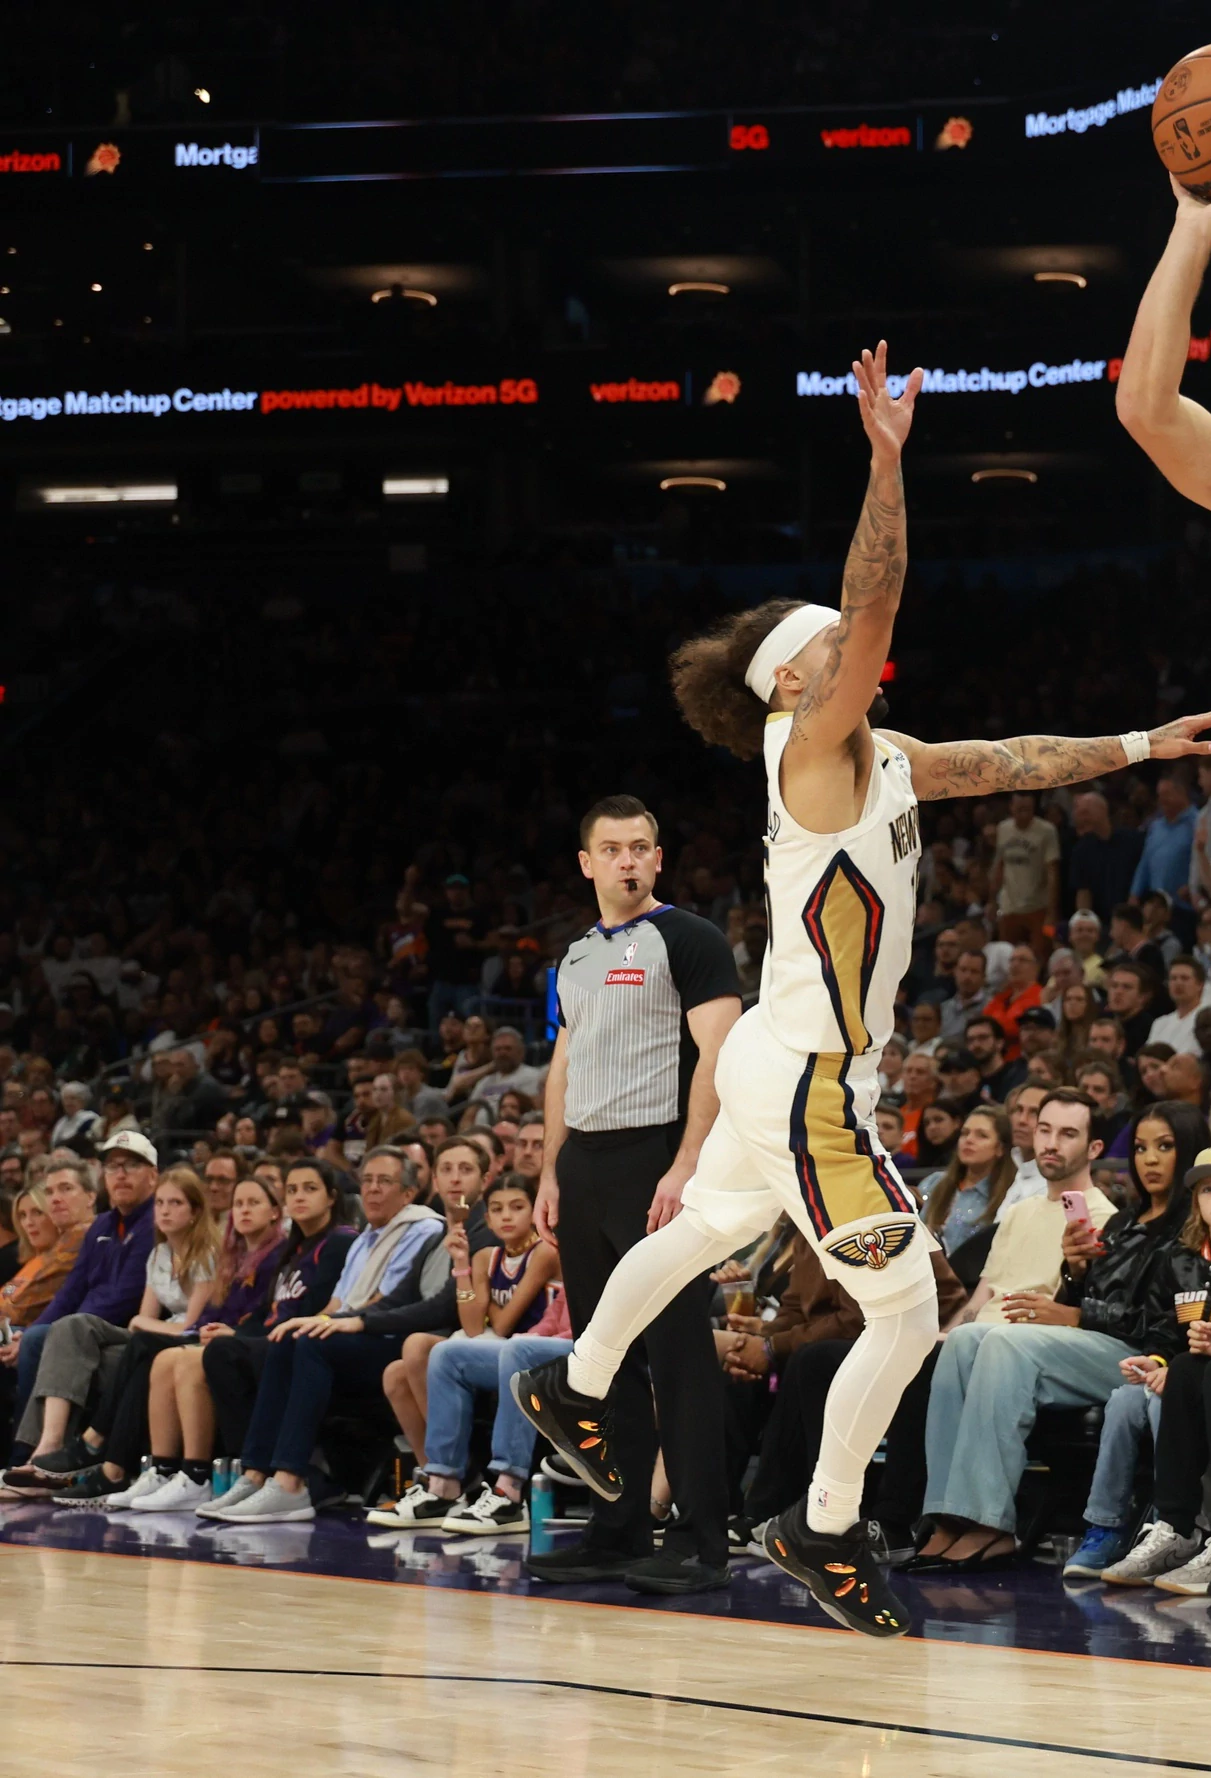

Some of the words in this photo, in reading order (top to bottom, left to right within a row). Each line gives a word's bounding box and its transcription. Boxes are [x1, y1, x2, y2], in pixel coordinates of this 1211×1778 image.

[1025, 99, 1117, 138] Mortgage
[1117, 77, 1163, 115] Matc
[820, 123, 911, 149] verizon
[590, 376, 681, 402] verizon
[919, 365, 1027, 395] Matchup
[1028, 358, 1107, 388] Center
[64, 389, 171, 417] Matchup
[172, 386, 258, 412] Center
[260, 382, 369, 415] powered
[370, 382, 401, 411] by
[402, 381, 497, 407] Verizon
[499, 377, 539, 404] 5G
[606, 971, 644, 982] Emirates
